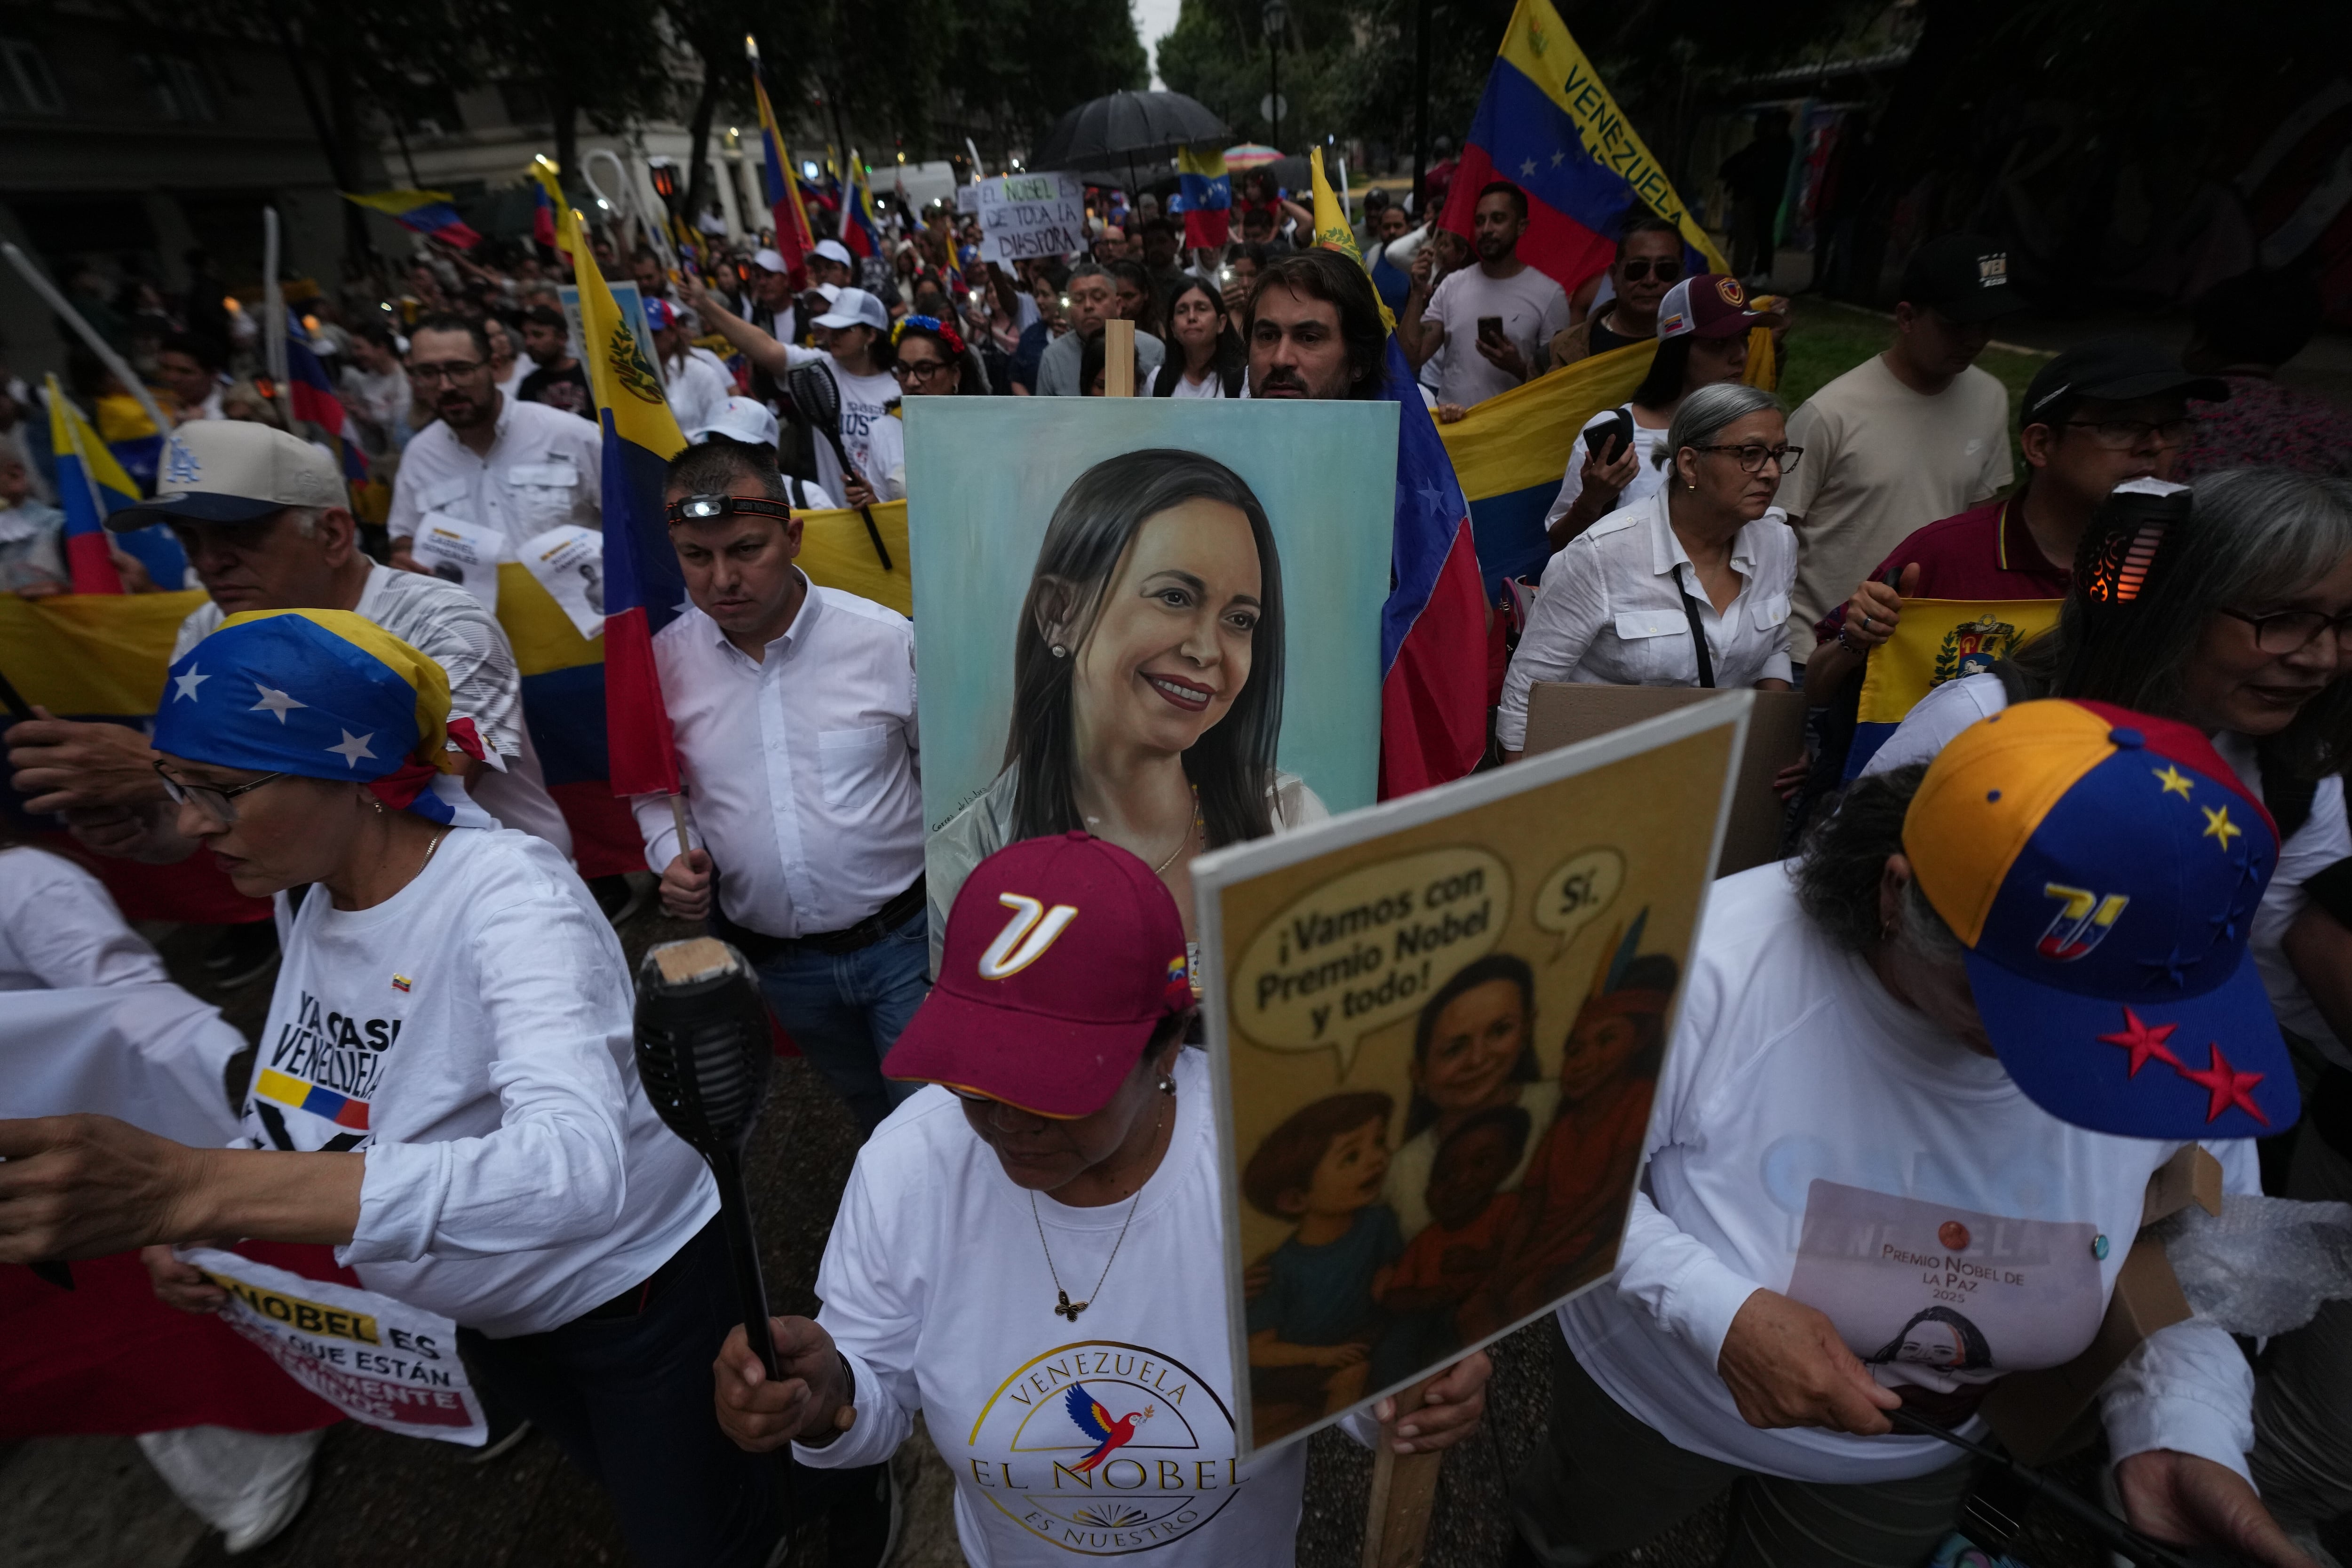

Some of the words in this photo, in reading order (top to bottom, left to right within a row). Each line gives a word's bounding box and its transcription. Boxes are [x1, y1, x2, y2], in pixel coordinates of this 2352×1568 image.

[1565, 64, 1682, 226] VENEZUELA
[983, 185, 998, 203] EL
[1005, 178, 1053, 202] NOBEL
[1058, 174, 1079, 198] ES
[986, 207, 1009, 228] DE
[1011, 205, 1053, 226] TODA
[1057, 203, 1077, 222] LA
[1560, 868, 1598, 915] Sí.
[1278, 891, 1412, 965] ¡Vamos
[1424, 868, 1483, 908] con
[1256, 945, 1382, 1010] Premio
[1394, 900, 1491, 962] Nobel
[1311, 1003, 1330, 1037] y
[1343, 961, 1431, 1019] todo!
[297, 990, 323, 1036] YA
[327, 1012, 401, 1052] CASI
[1923, 1272, 1940, 1286] LA
[1933, 1289, 1965, 1303] 2025
[2004, 1272, 2025, 1286] DE
[389, 1328, 440, 1360] ES
[356, 1351, 451, 1386] ESTÁN
[1009, 1352, 1188, 1406] VENEZUELA
[968, 1458, 1028, 1489] EL
[1053, 1457, 1251, 1490] NOBEL
[1025, 1511, 1055, 1530] ES
[1064, 1511, 1198, 1548] NUESTRO
